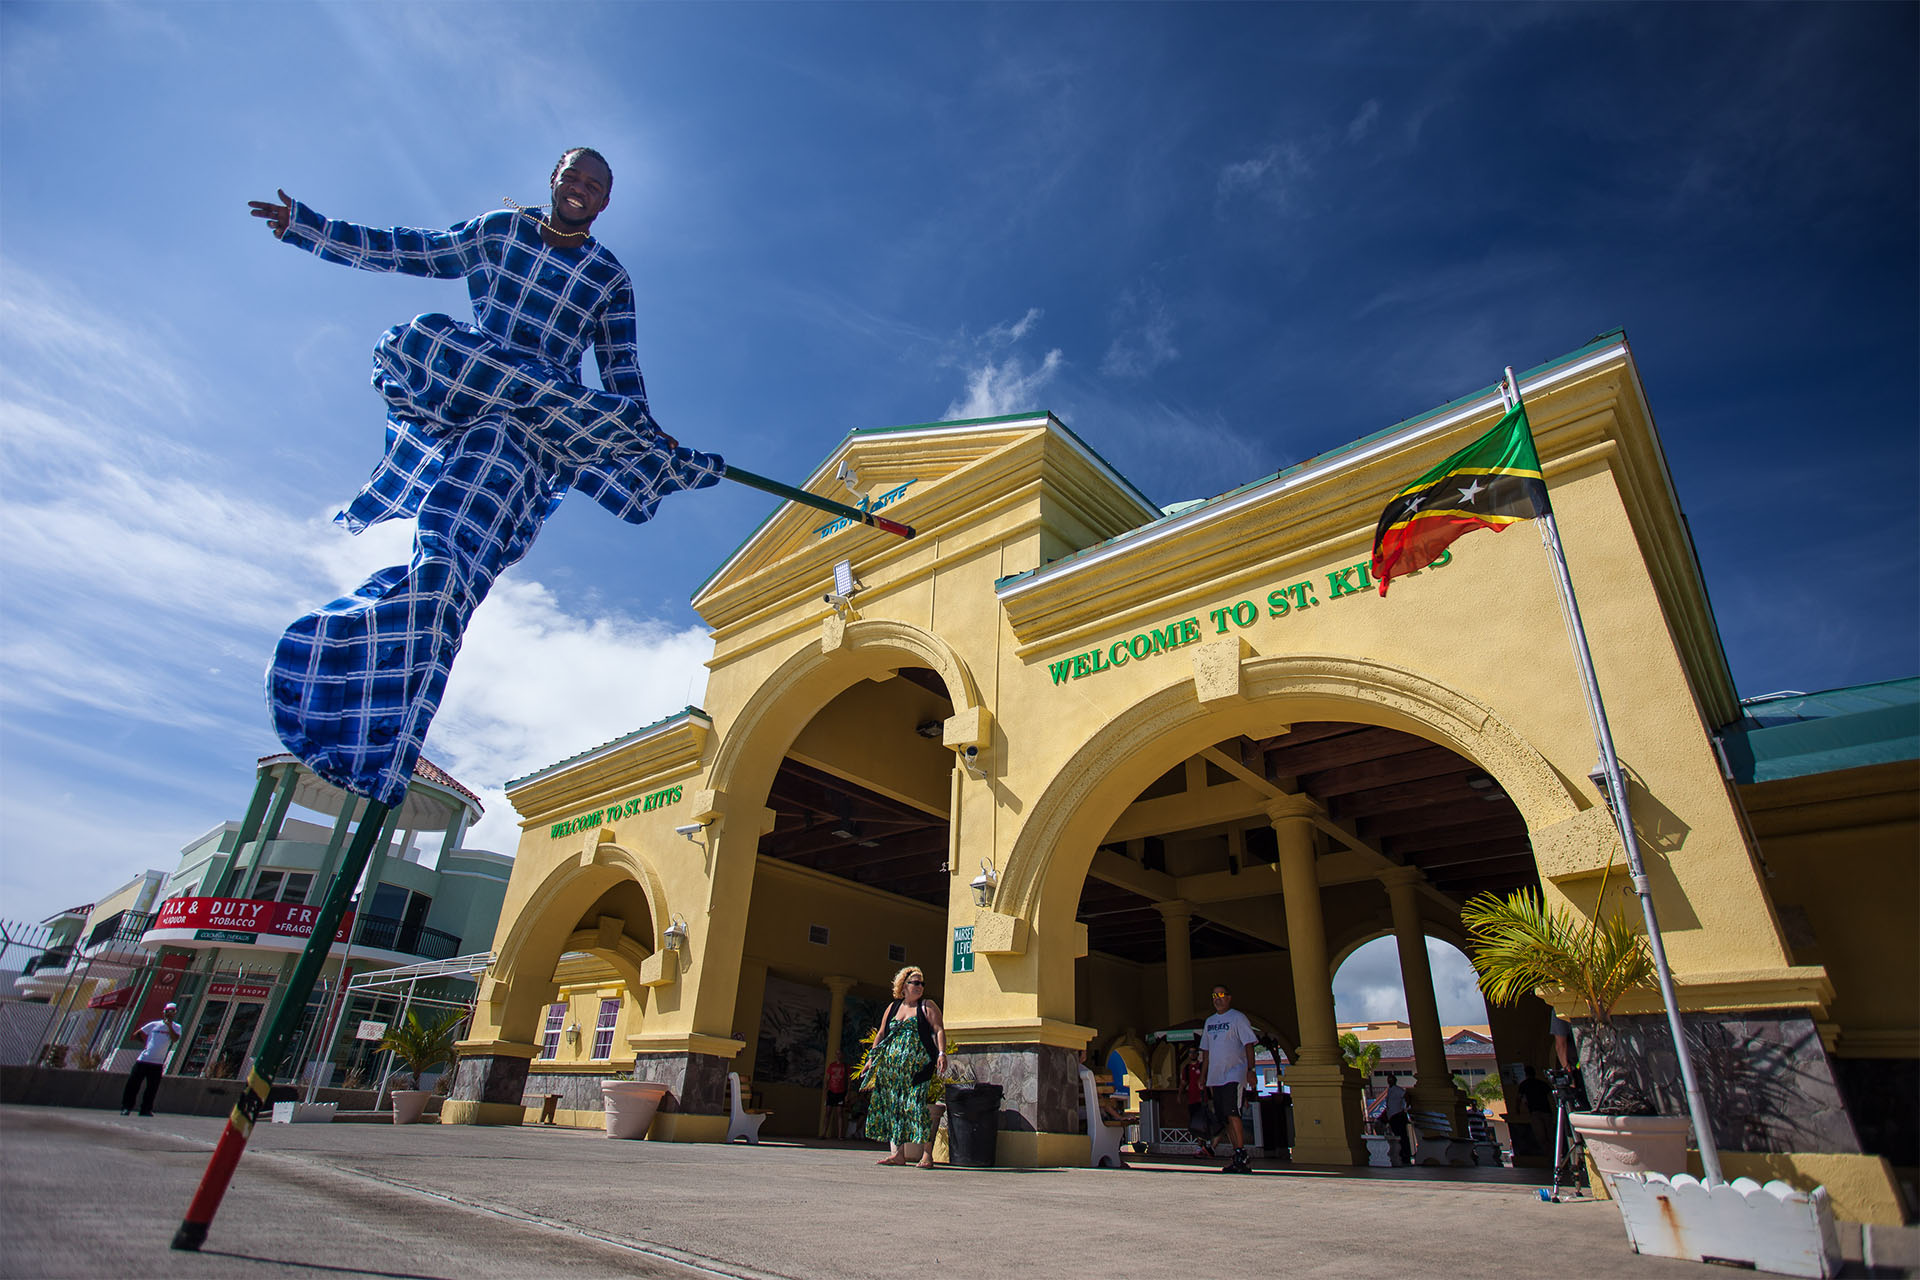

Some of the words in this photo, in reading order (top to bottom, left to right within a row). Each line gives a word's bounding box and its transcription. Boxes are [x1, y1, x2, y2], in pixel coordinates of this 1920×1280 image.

[1048, 617, 1200, 685] WELCOME
[1210, 600, 1257, 634] TO
[1267, 580, 1318, 617] ST.
[550, 809, 604, 839] WELCOME
[606, 804, 622, 823] TO
[623, 798, 641, 817] ST.
[642, 785, 683, 812] KITTS
[162, 901, 185, 916] TAX
[188, 900, 199, 915] &
[210, 901, 264, 918] DUTY
[960, 956, 966, 972] 1
